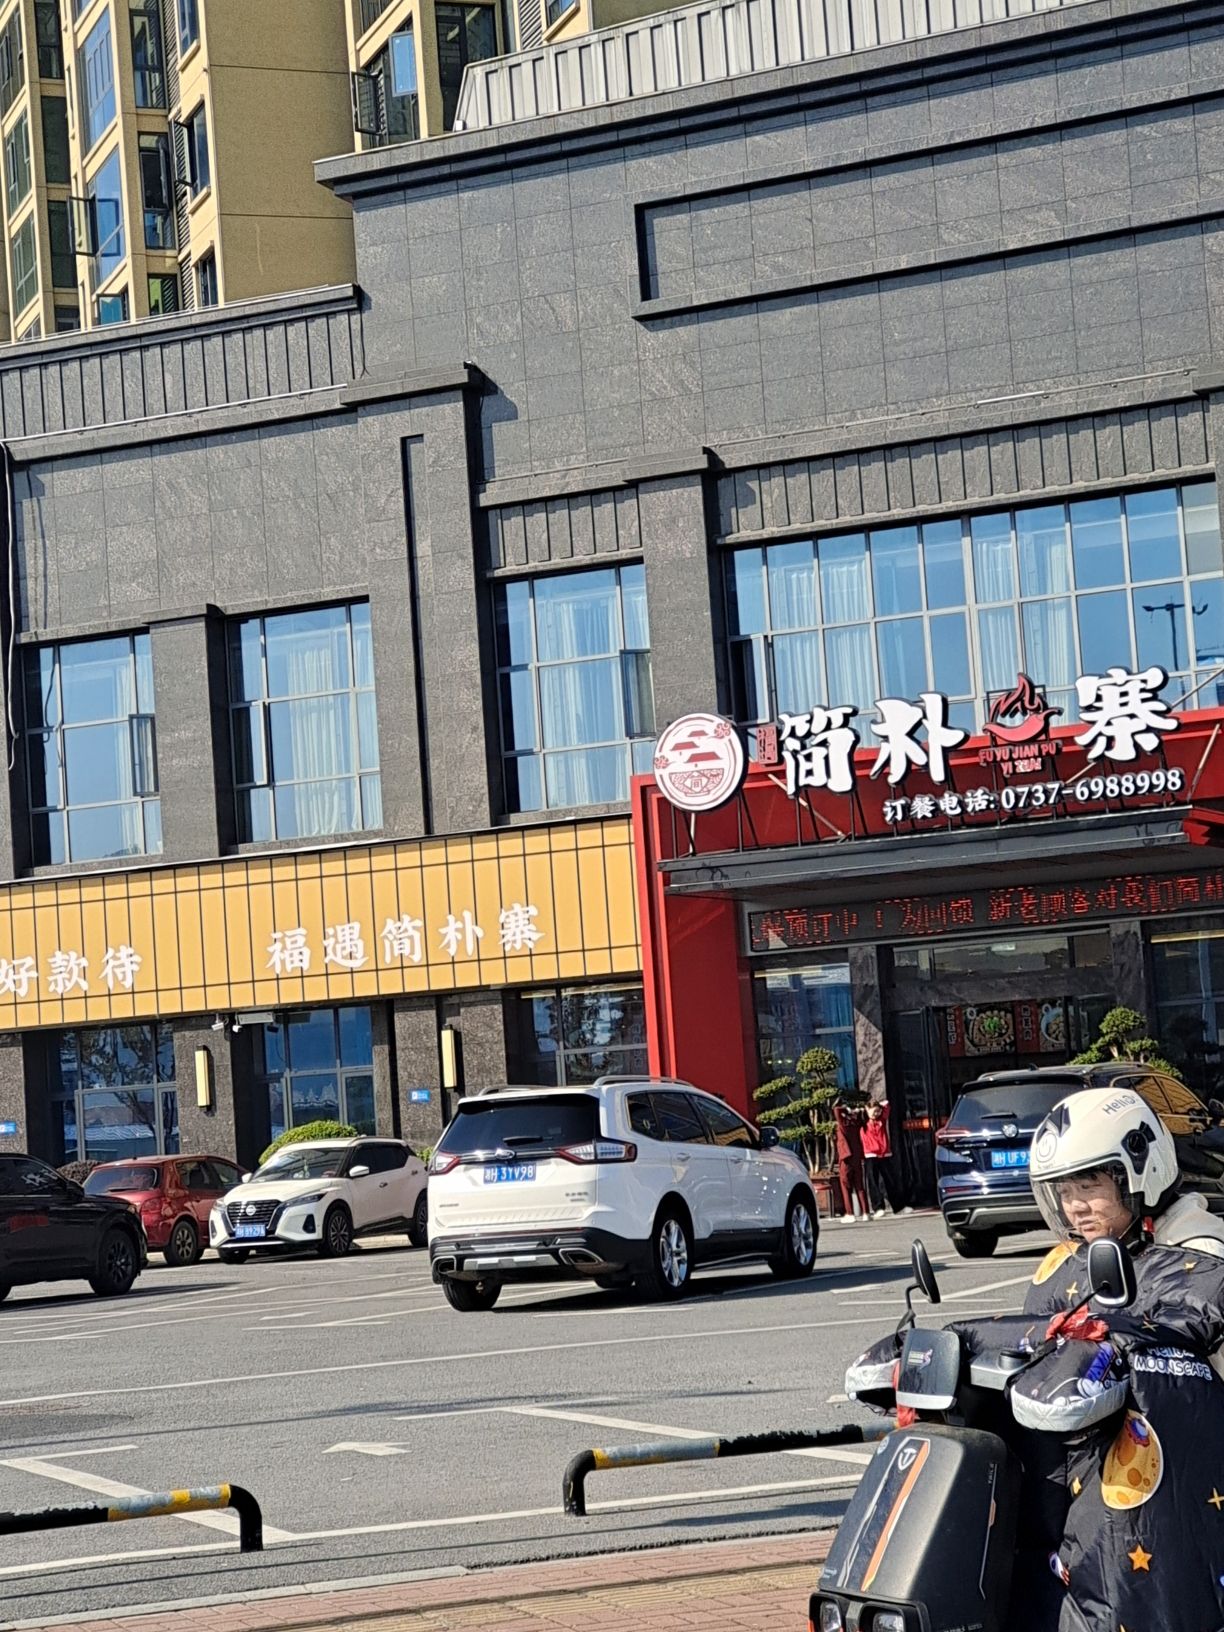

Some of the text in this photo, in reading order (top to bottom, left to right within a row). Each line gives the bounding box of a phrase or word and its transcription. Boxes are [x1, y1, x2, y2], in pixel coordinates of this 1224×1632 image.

[780, 666, 1180, 797] 简朴寨
[995, 748, 1010, 760] YU
[1012, 744, 1039, 758] JIAN
[1041, 743, 1056, 756] PU
[265, 902, 546, 975] 福遇简朴寨
[0, 945, 142, 997] 好款待
[1134, 1354, 1213, 1381] MOONSCAPE
